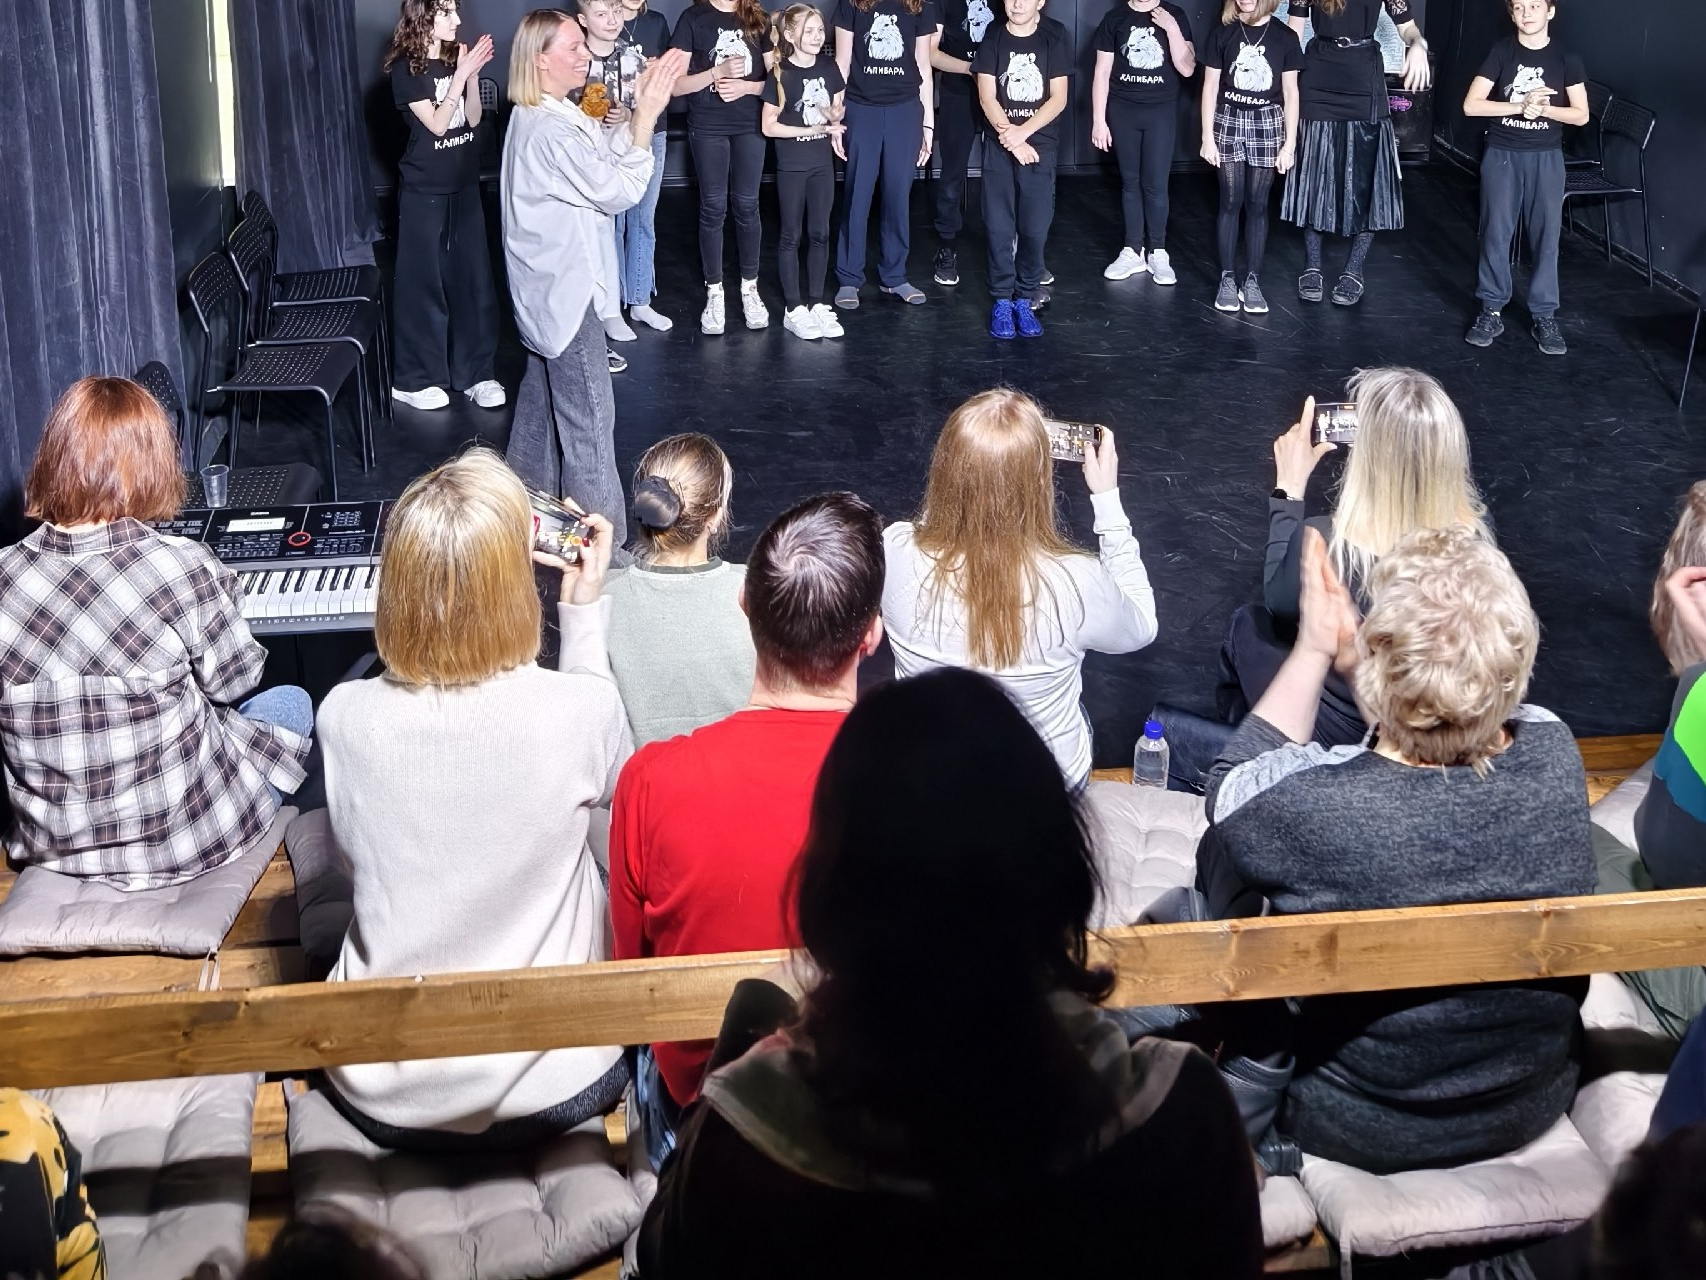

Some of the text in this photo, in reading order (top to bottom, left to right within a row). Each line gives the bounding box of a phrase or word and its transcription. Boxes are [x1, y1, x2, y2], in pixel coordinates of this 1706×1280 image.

[1119, 73, 1165, 84] КАПИБАРА
[1004, 108, 1039, 118] АПИБА
[1501, 117, 1550, 130] КАПИБАРА
